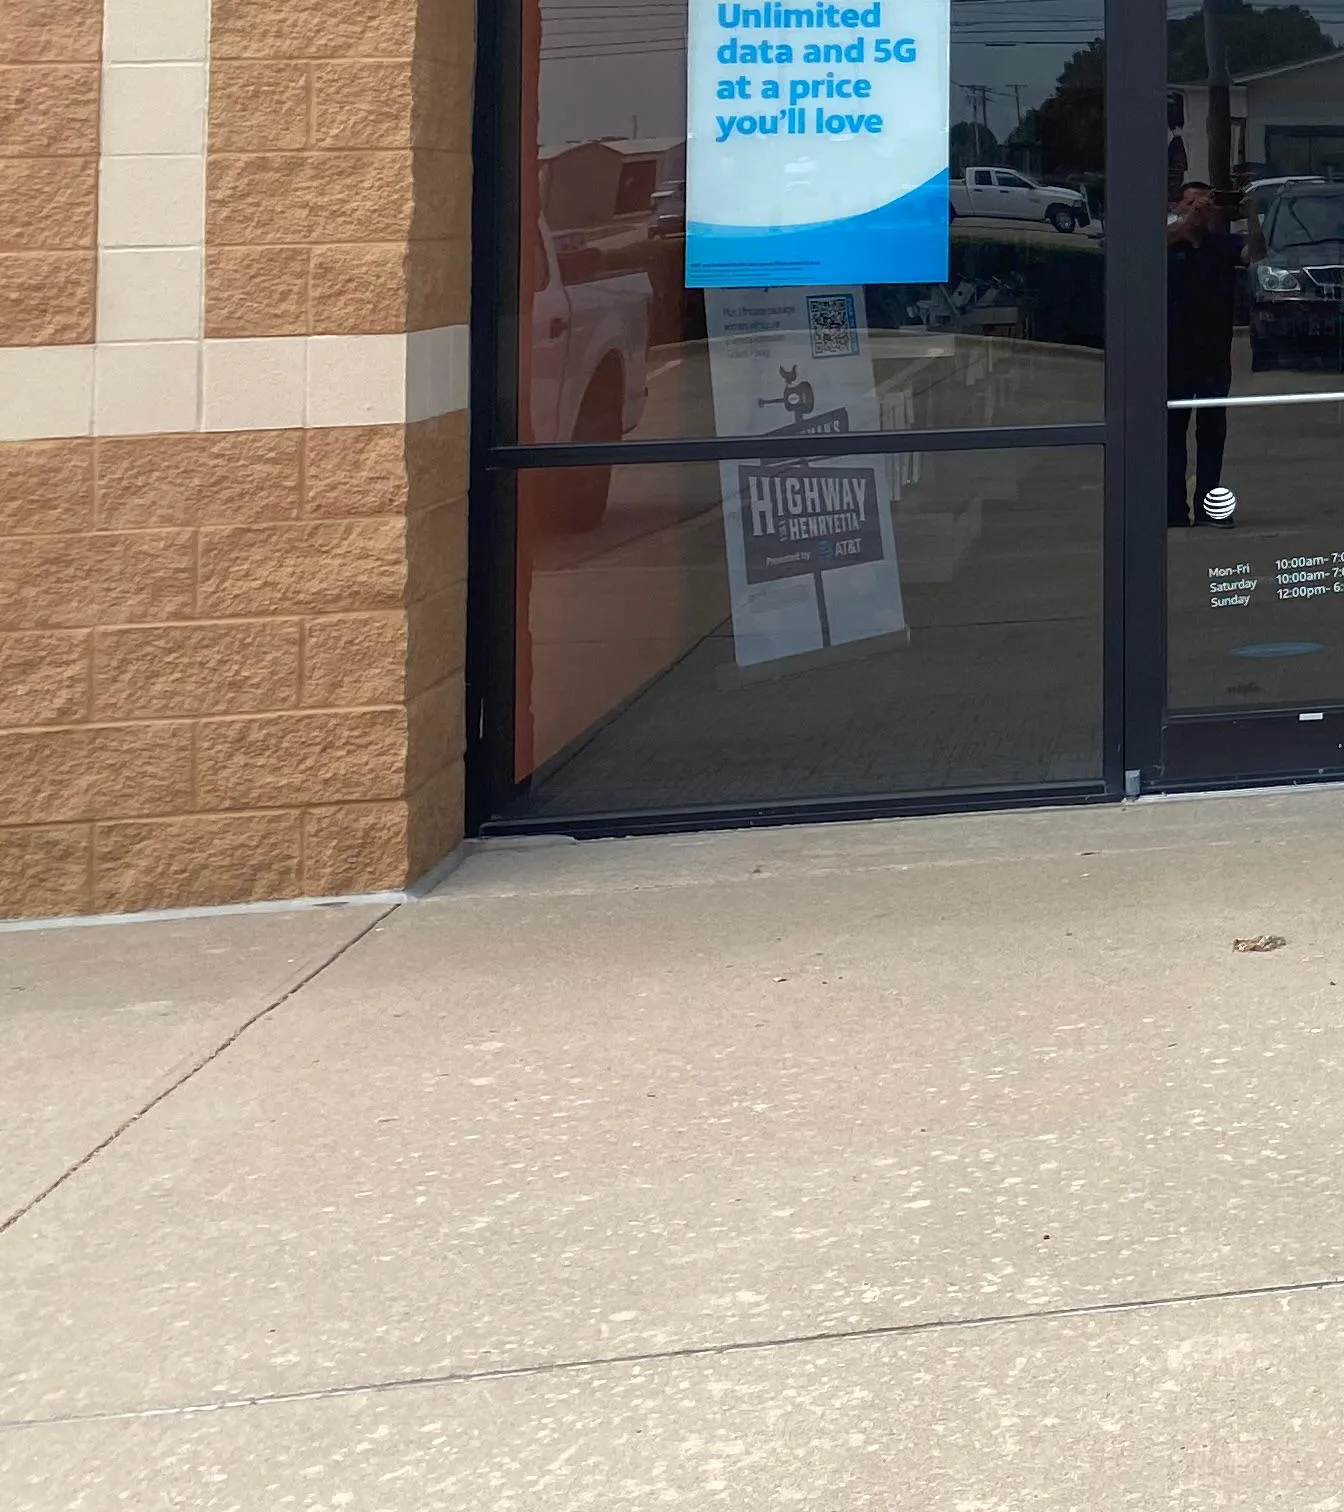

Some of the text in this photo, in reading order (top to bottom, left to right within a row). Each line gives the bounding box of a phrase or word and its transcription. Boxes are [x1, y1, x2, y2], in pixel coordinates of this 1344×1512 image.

[717, 1, 881, 29] Unlimited
[716, 37, 917, 65] data and 5G
[716, 72, 872, 106] at a price
[715, 108, 883, 143] you'll love
[748, 476, 867, 536] HIGHWAY
[835, 538, 862, 556] AT&T
[1208, 563, 1250, 578] Mon-Fri
[1275, 556, 1329, 570] 10:00am-
[1209, 578, 1257, 593] Saturday
[1276, 570, 1330, 585] 10:00am-
[1210, 593, 1251, 608] Sunday
[1276, 585, 1331, 600] 12:00pm-
